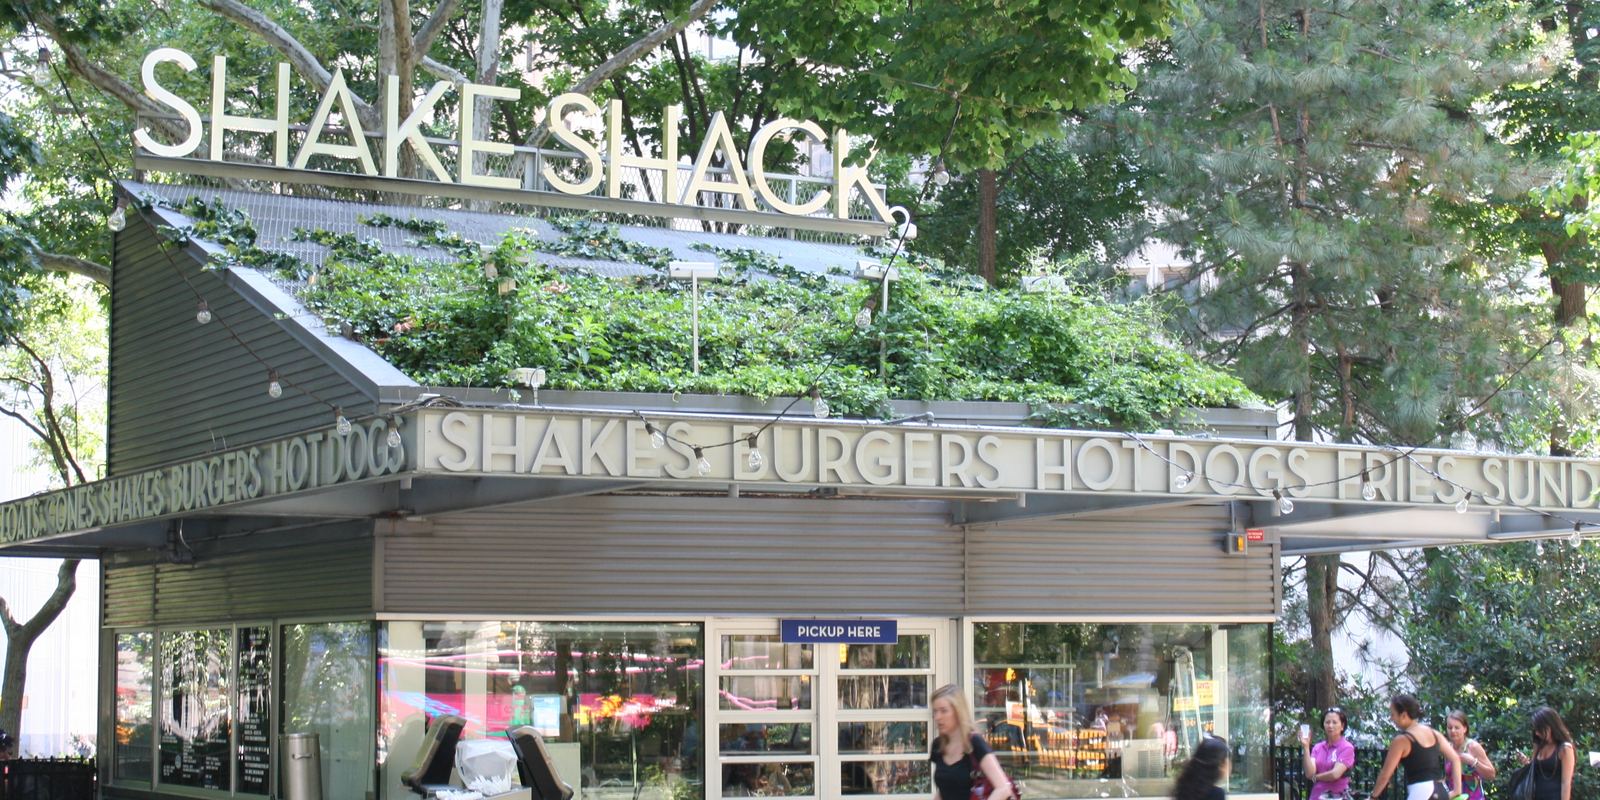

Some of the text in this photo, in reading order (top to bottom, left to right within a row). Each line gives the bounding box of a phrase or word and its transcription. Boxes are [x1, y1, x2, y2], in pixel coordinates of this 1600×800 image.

[133, 48, 896, 224] SHAKE SHACK
[46, 484, 96, 533] CONES
[100, 470, 164, 525] SHAKES
[171, 446, 261, 512] BURGERS
[271, 432, 323, 494] HOT
[438, 411, 1598, 508] SHAKES BURGERS HOT DOGS FRIES SUND
[798, 626, 880, 637] PICKUP HERE
